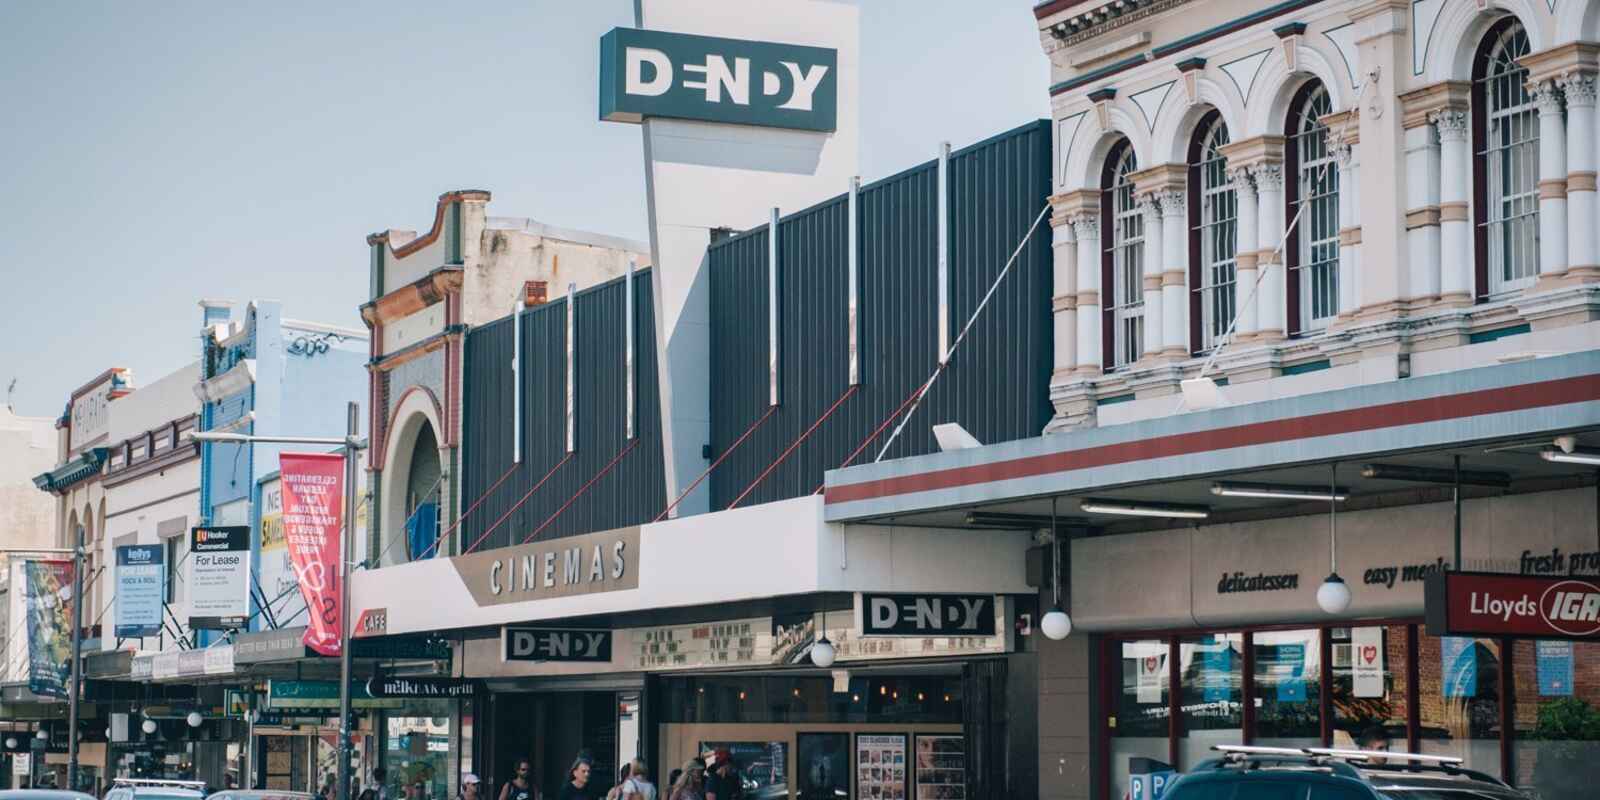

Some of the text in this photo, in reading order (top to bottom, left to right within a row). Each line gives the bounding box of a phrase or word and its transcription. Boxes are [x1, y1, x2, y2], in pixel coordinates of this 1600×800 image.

[625, 46, 829, 111] DENDY
[195, 555, 240, 566] For Lease
[489, 540, 626, 595] CINEMAS
[1520, 548, 1564, 576] fresh
[1217, 571, 1299, 595] delicatessen
[1363, 565, 1398, 589] easy
[870, 597, 985, 630] DENDY
[1470, 591, 1600, 622] Lloyds IGA
[363, 612, 386, 633] CAFE
[512, 631, 606, 658] DENDY
[449, 683, 473, 696] grill
[1153, 775, 1165, 795] P
